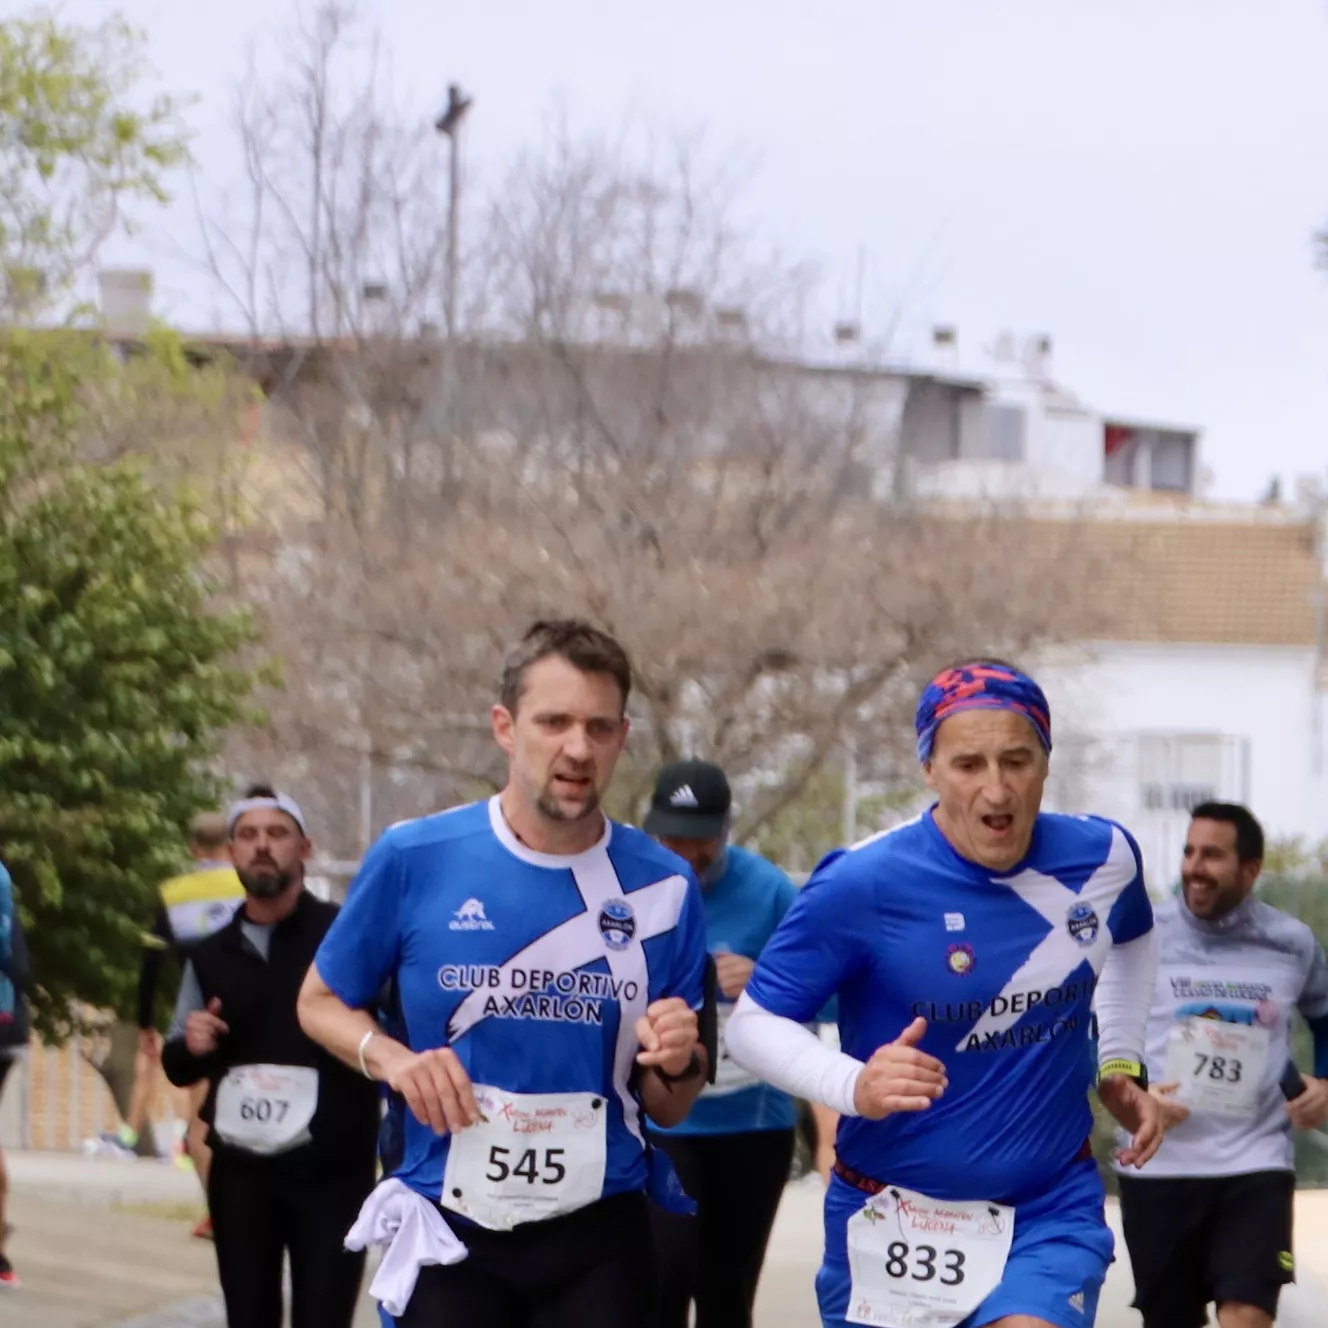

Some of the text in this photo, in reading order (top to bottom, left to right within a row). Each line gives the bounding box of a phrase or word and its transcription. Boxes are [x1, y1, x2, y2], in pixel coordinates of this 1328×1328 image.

[438, 966, 640, 1001] CLUB DEPORTIVO
[483, 994, 602, 1024] AXARLÓN
[1193, 1051, 1243, 1083] 783
[240, 1096, 290, 1124] 607
[485, 1145, 566, 1184] 545
[885, 1240, 966, 1286] 833
